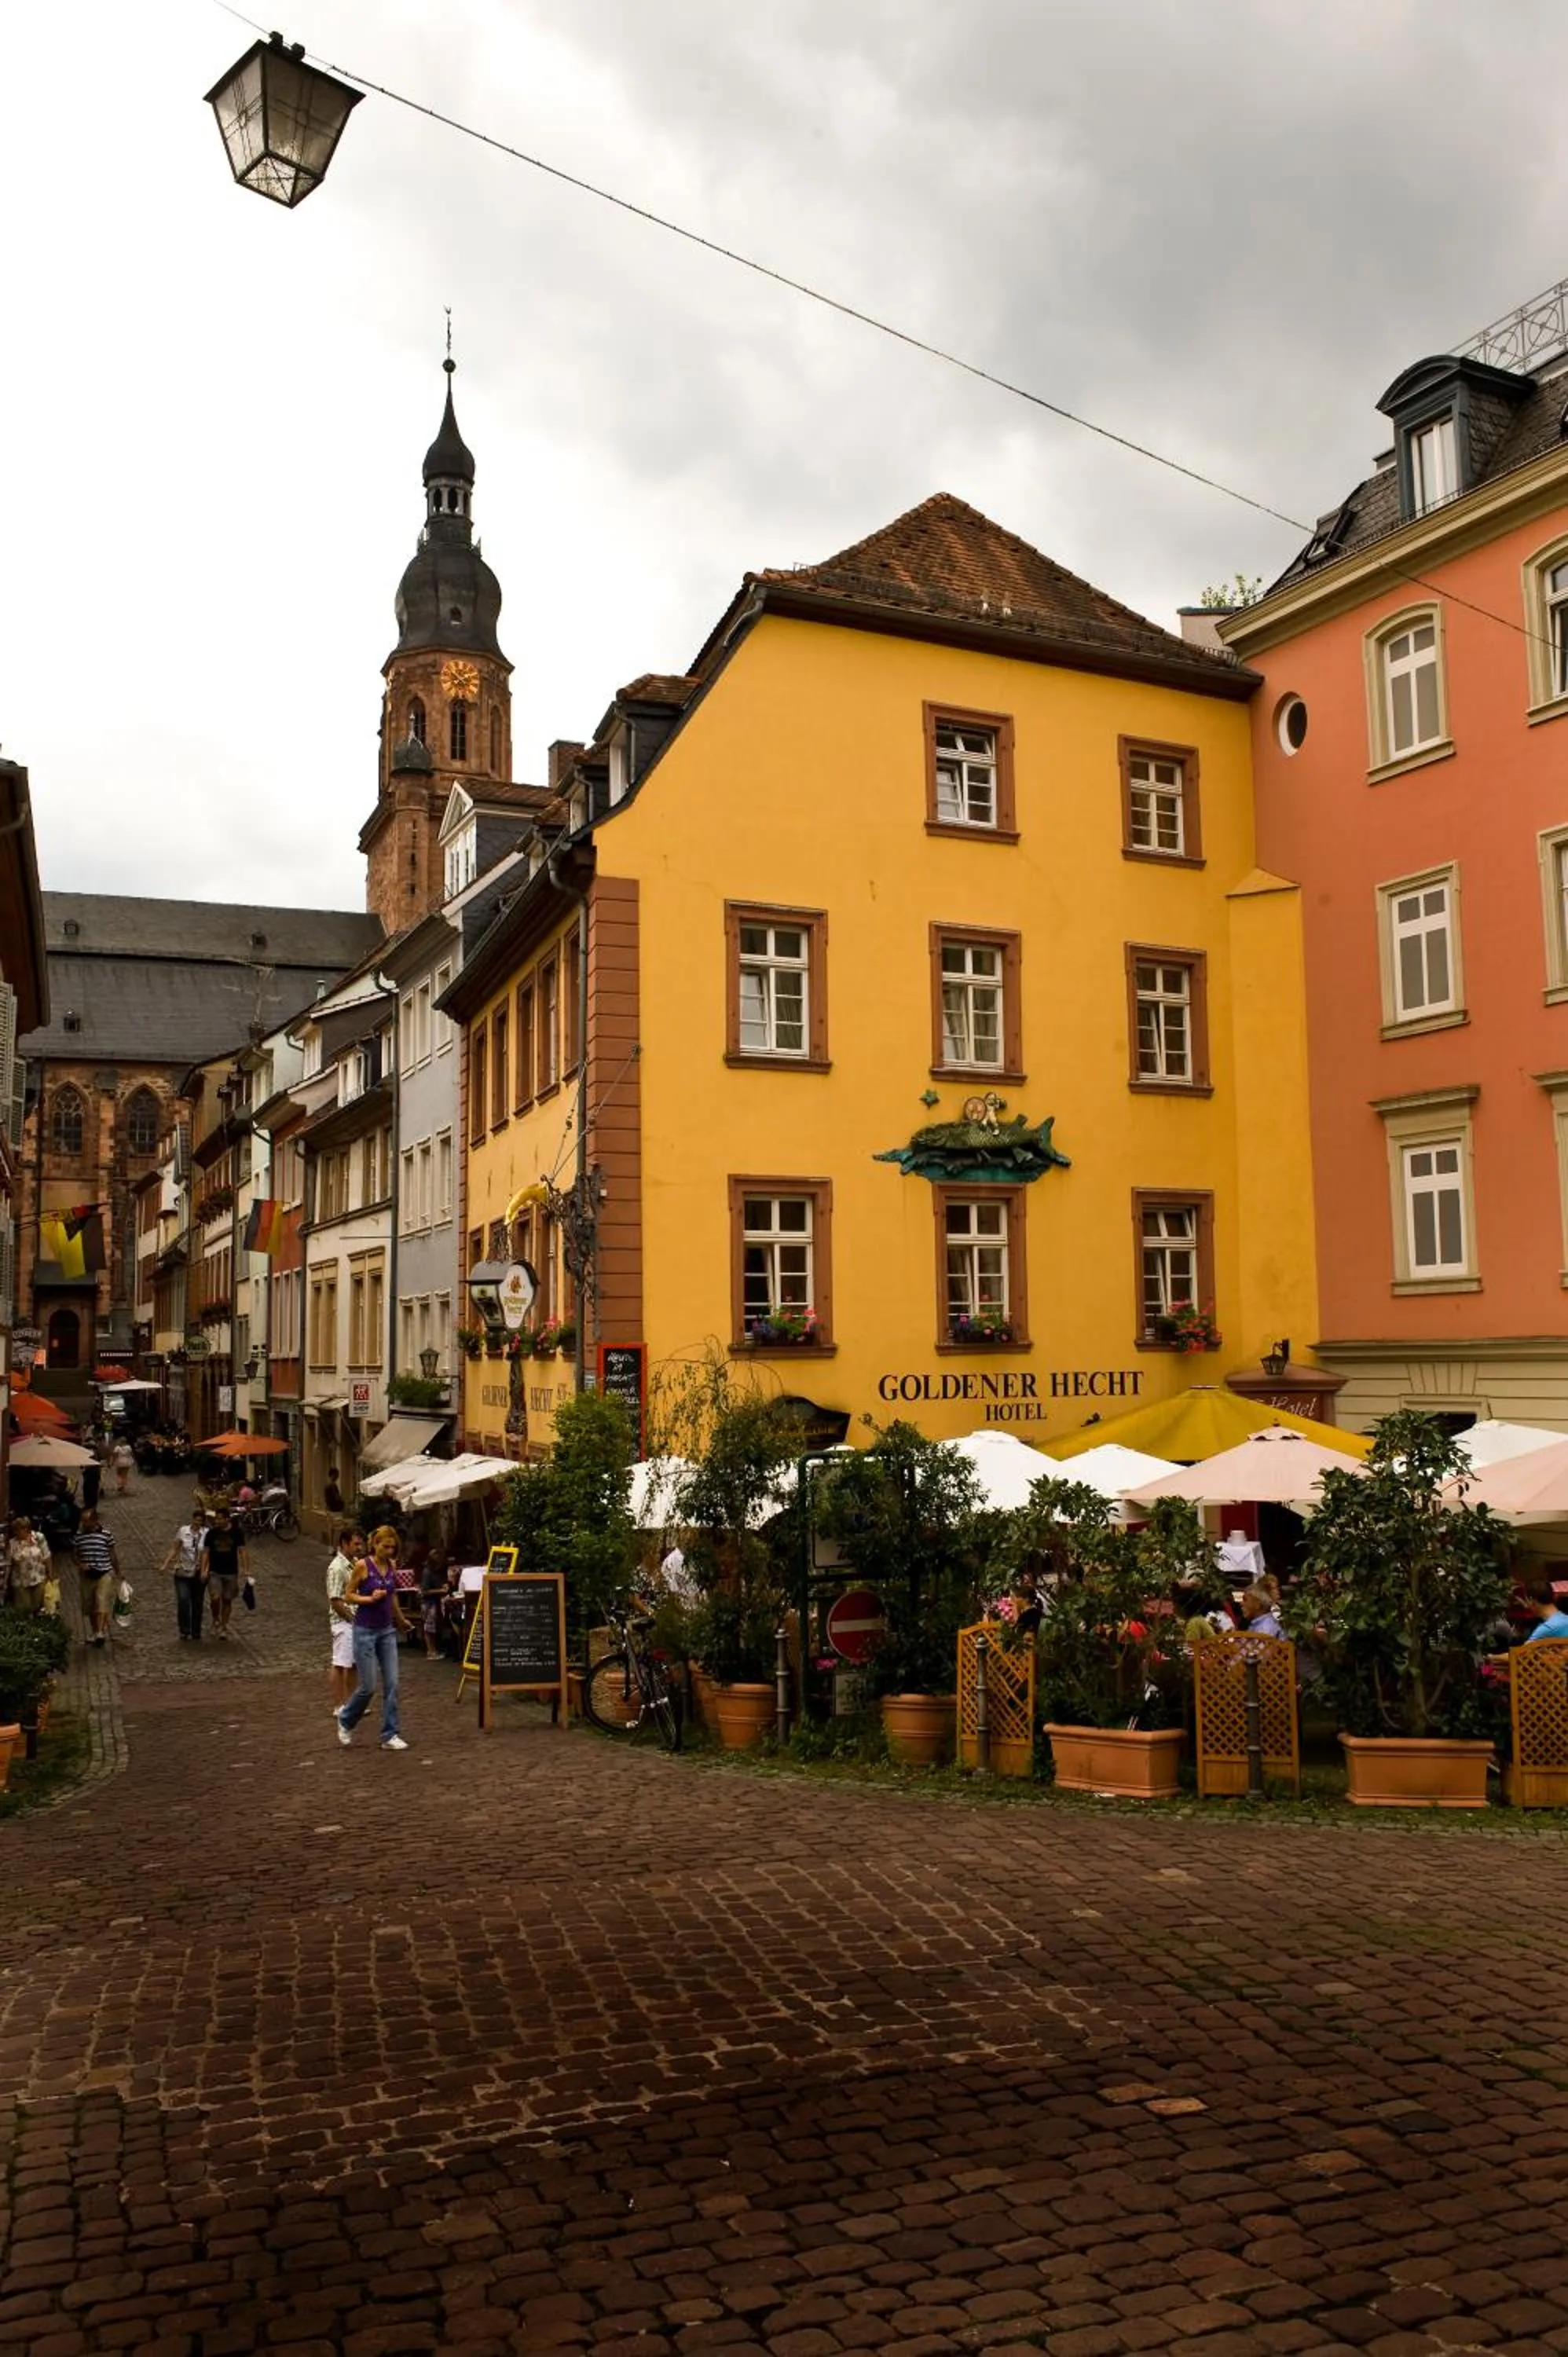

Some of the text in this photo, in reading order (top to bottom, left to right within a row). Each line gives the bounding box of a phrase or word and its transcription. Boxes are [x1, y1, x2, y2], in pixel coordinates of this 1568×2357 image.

[878, 1370, 1145, 1401] GOLDENER HECHT
[985, 1403, 1047, 1422] HOTEL
